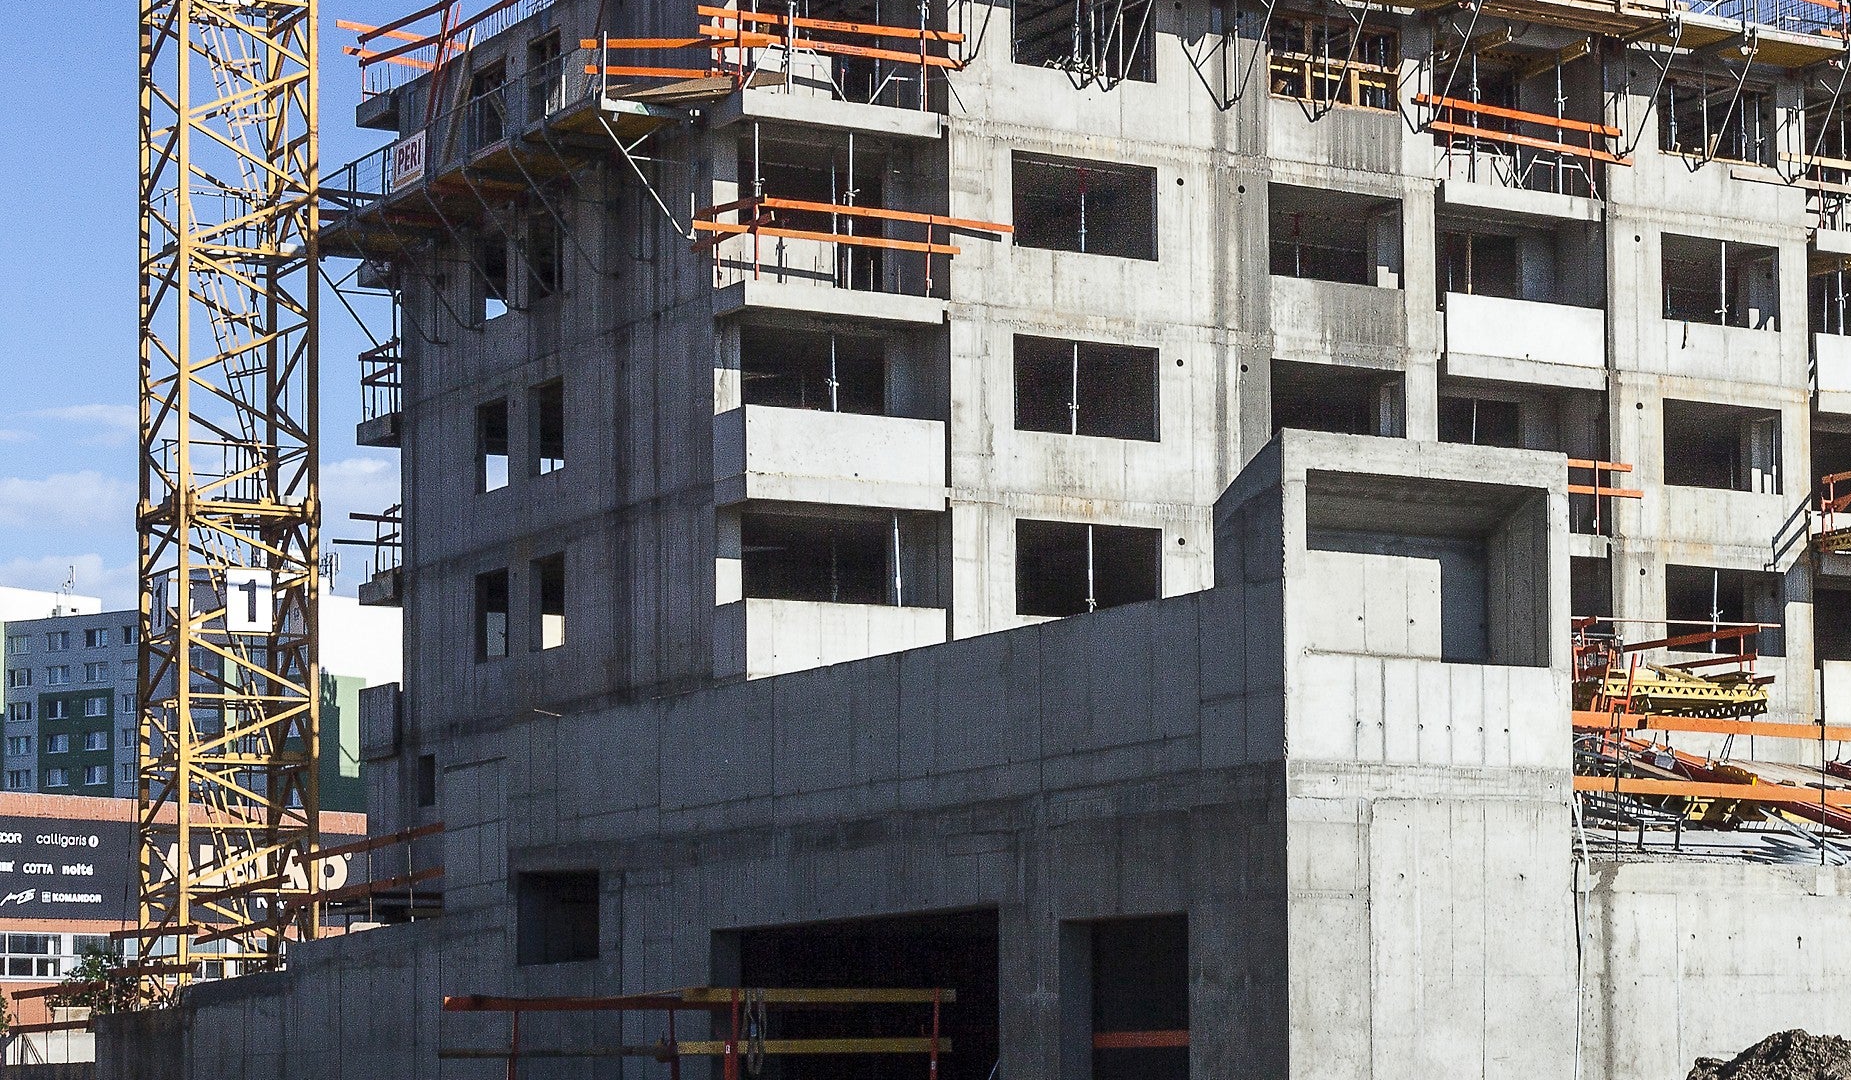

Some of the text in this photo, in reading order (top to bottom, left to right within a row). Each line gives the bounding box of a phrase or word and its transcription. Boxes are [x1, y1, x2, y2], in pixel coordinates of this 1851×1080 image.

[398, 137, 421, 175] PERI
[239, 579, 257, 623] 1
[36, 833, 87, 848] calligaris
[22, 863, 54, 875] COTTA
[51, 893, 102, 904] KOMANDOR
